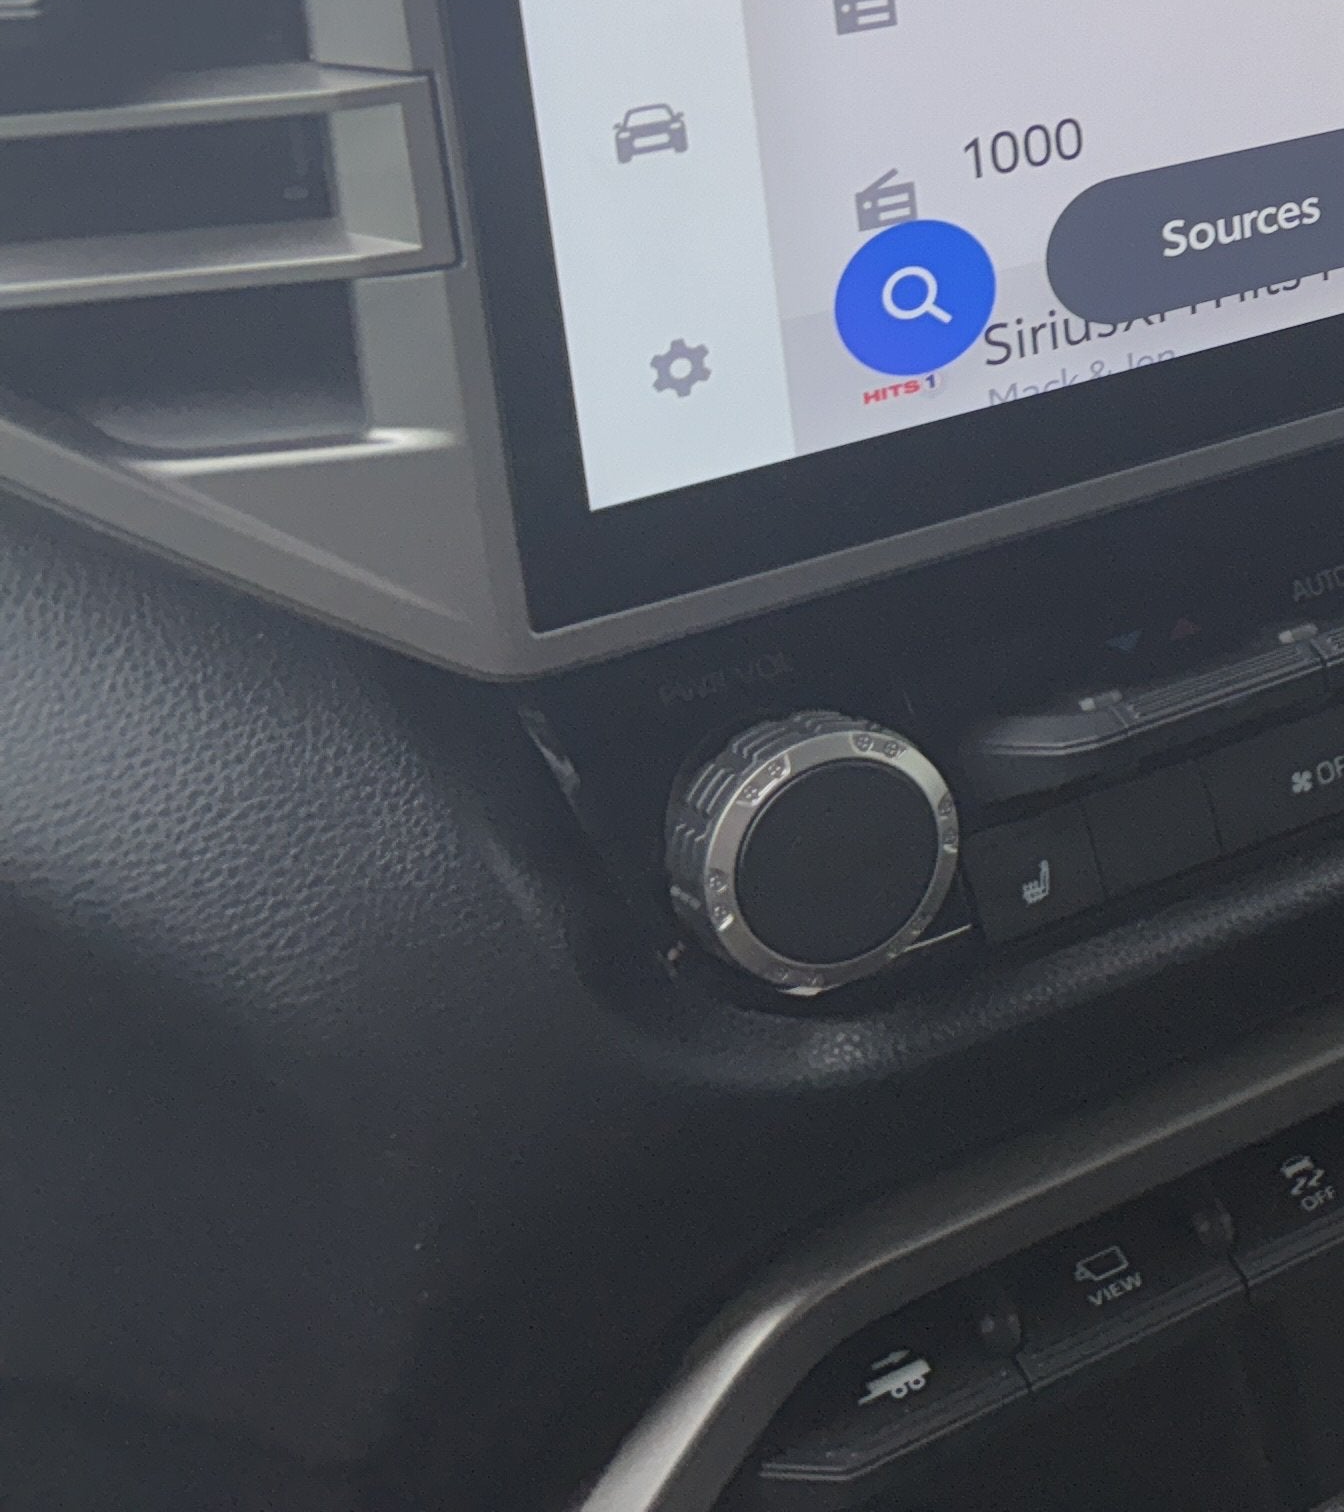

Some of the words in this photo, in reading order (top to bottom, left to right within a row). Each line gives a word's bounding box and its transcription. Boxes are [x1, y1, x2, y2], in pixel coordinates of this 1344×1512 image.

[962, 118, 1084, 180] 1000
[1161, 195, 1322, 258] Sources
[984, 309, 1197, 365] Siriu
[863, 380, 920, 404] HITS
[1301, 1186, 1336, 1211] OFF
[1087, 1272, 1142, 1305] VIEW
